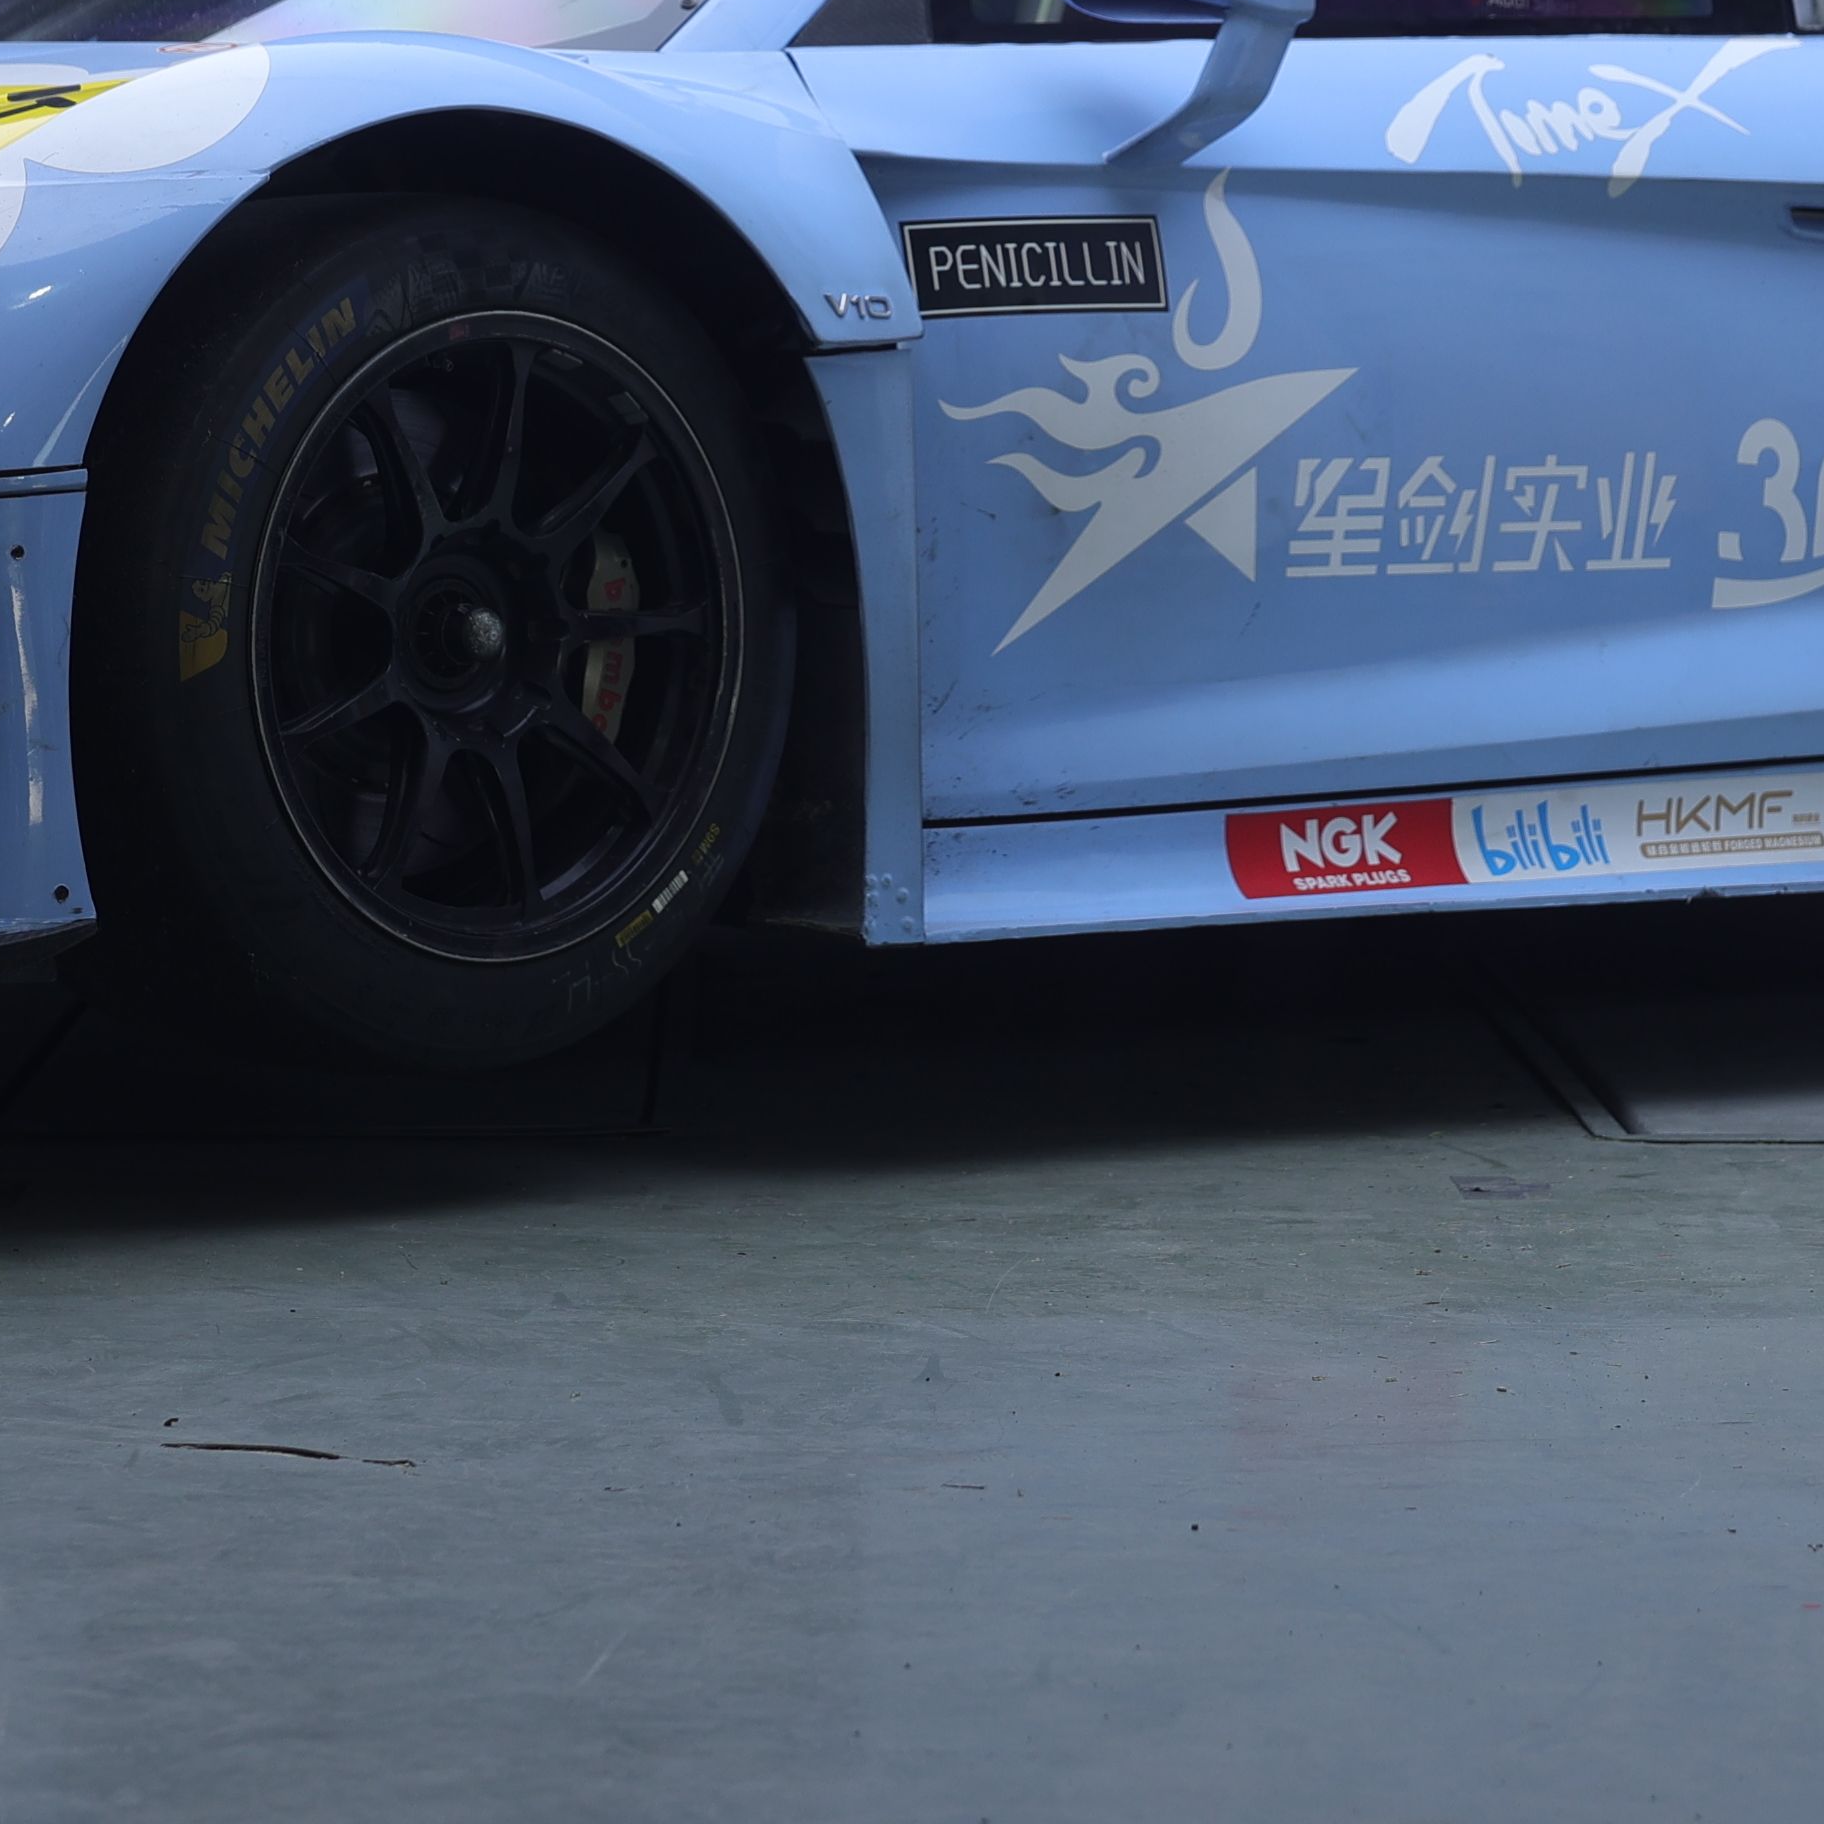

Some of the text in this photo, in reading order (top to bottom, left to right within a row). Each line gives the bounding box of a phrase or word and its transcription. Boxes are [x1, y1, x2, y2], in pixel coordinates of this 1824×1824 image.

[928, 240, 1146, 291] PENICILLIN
[824, 292, 892, 320] V10
[200, 295, 358, 561] MICHELIN
[592, 578, 626, 732] bmbo
[1471, 799, 1612, 877] bilibili
[1636, 789, 1794, 837] HKMF
[1279, 811, 1403, 873] NGK
[1293, 868, 1412, 891] SPARK PLUGS
